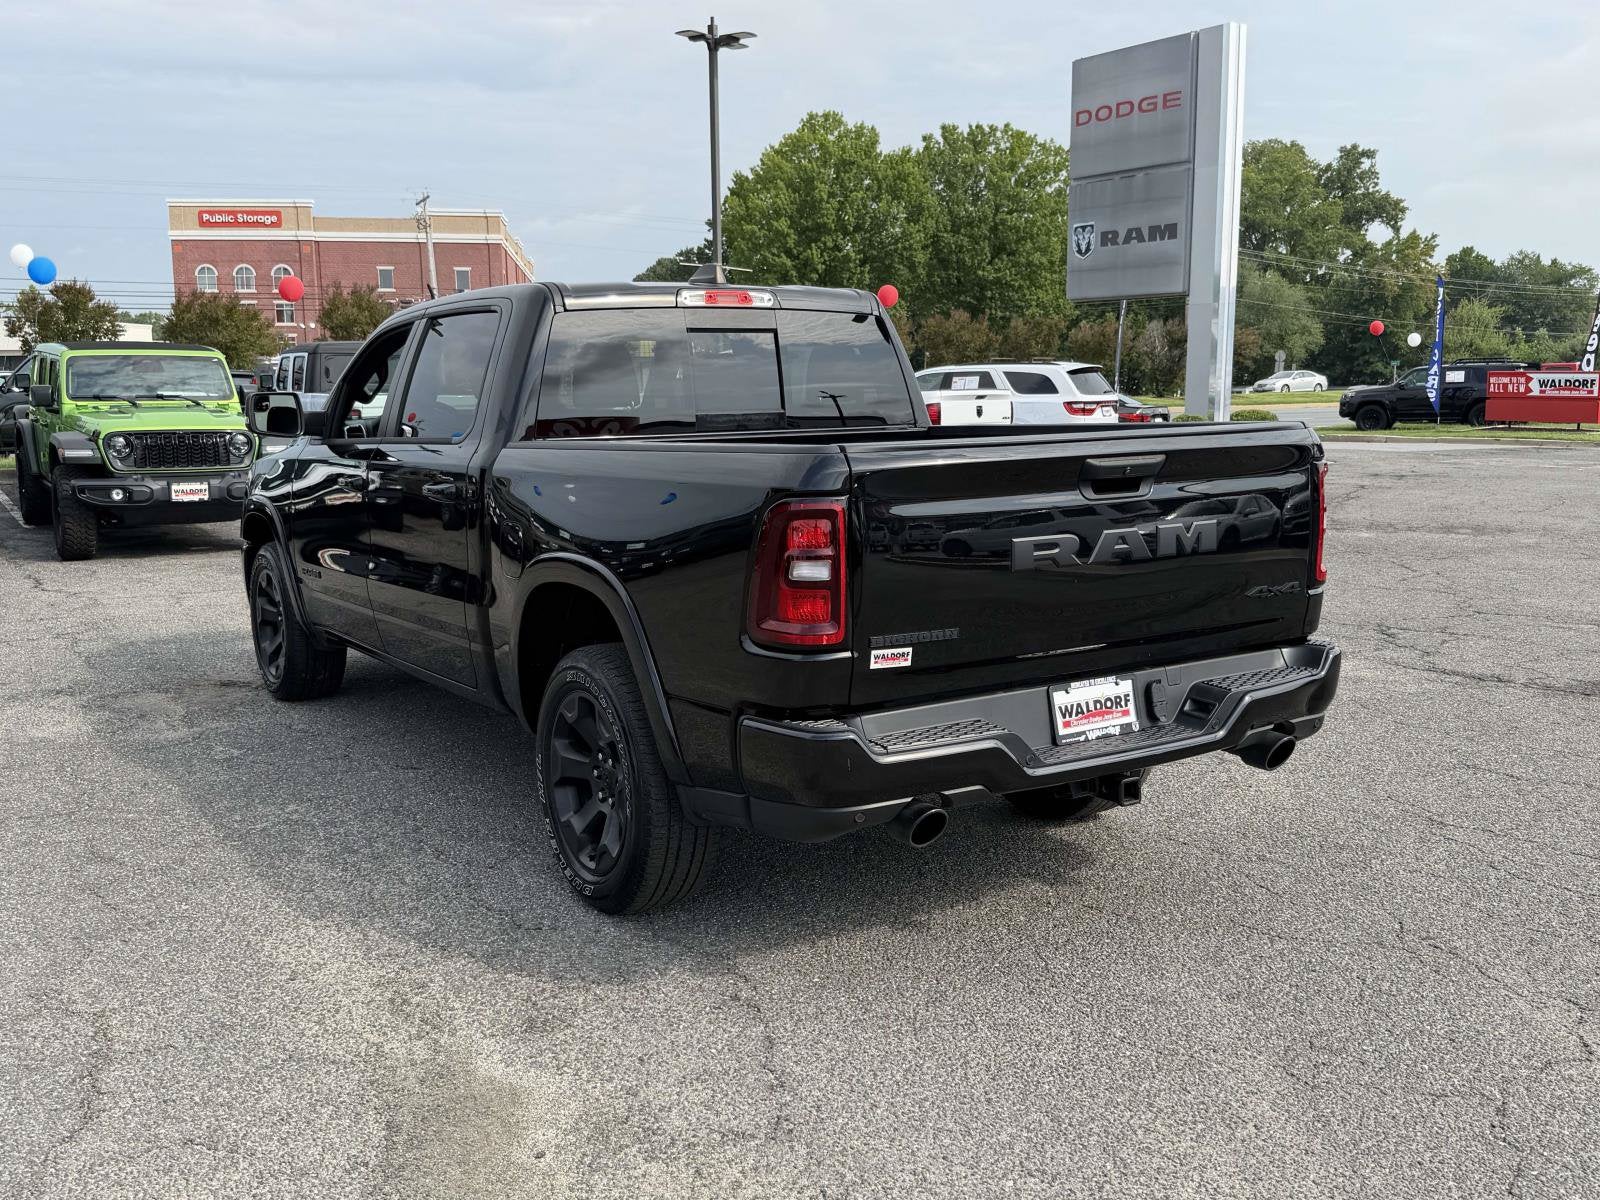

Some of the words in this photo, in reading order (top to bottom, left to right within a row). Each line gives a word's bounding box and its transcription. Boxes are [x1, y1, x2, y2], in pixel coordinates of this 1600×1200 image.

[1075, 91, 1182, 128] DODGE
[203, 213, 235, 223] Public
[237, 213, 278, 225] Storage
[1100, 223, 1178, 248] RAM
[1490, 384, 1504, 393] ALL
[1508, 383, 1526, 393] NEW
[1538, 379, 1597, 389] WALDORF
[1010, 519, 1218, 573] RAM
[873, 651, 911, 661] WALDORF
[1058, 694, 1131, 719] WALDORF
